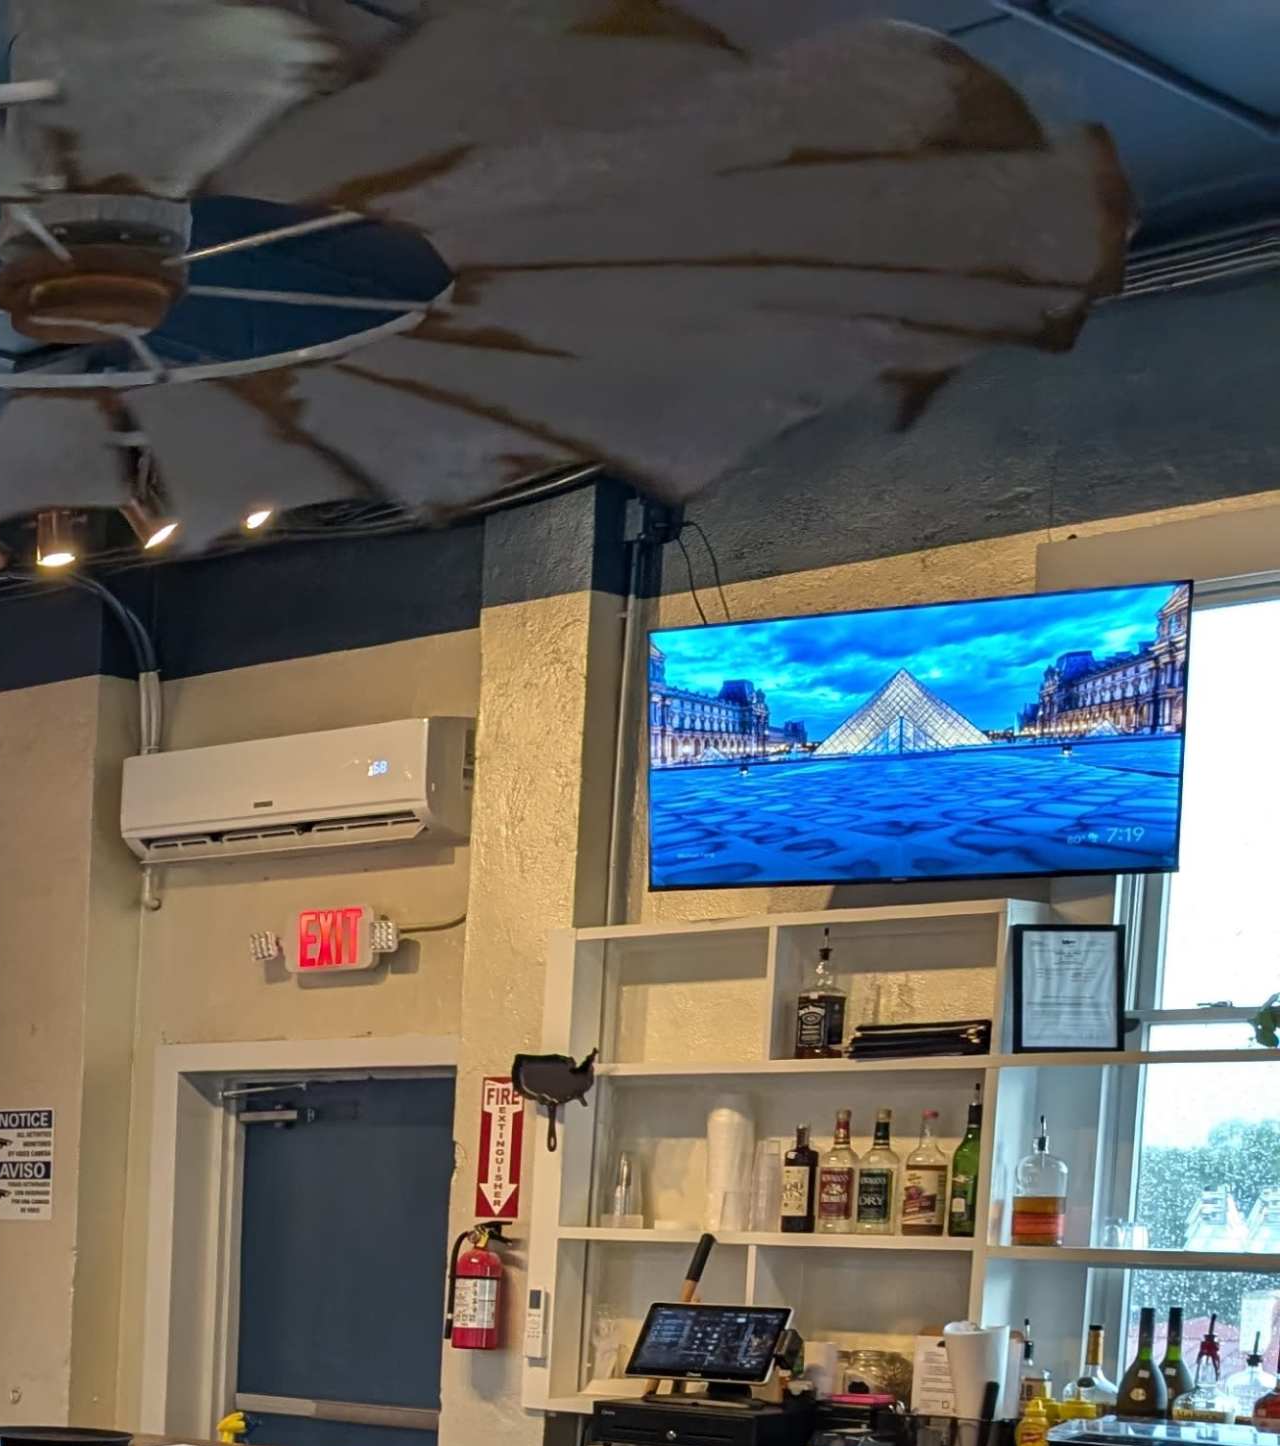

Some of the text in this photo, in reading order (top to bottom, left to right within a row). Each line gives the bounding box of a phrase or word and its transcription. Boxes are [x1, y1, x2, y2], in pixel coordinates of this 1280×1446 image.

[1106, 826, 1145, 843] 7:19
[299, 908, 362, 968] EXIT
[486, 1087, 520, 1106] FIRE
[493, 1106, 507, 1207] EXTINGUISHER
[0, 1161, 46, 1179] AVISO
